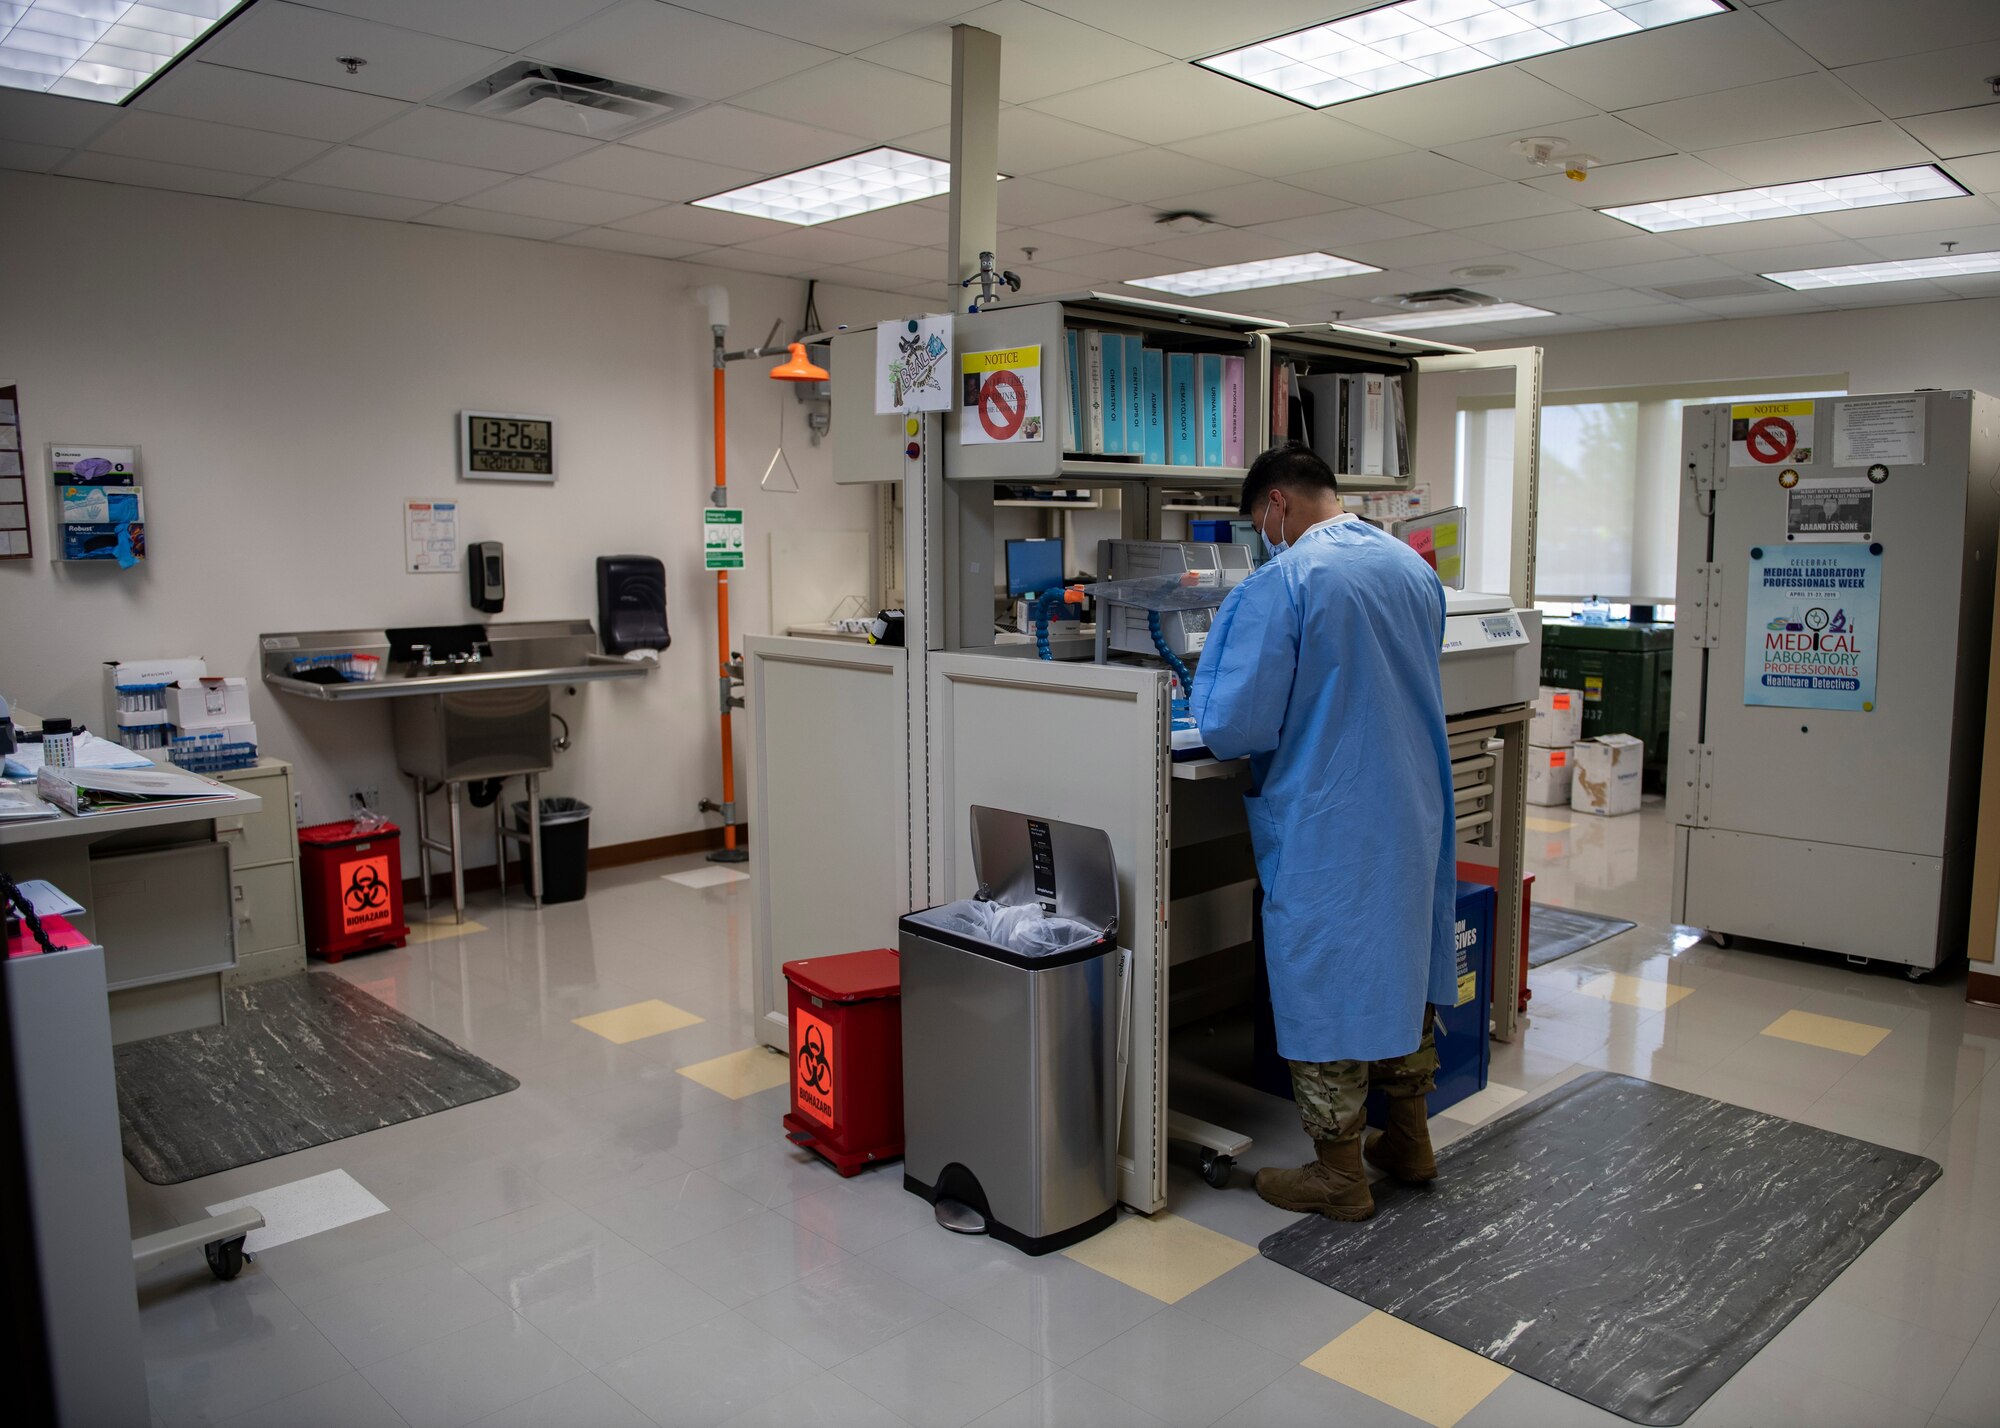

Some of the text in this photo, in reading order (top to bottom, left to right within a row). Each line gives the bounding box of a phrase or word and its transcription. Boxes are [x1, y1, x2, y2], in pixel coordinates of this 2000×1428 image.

[985, 352, 1018, 365] NOTICE
[1754, 405, 1789, 414] NOTICE
[483, 422, 532, 449] 13:26
[1828, 523, 1839, 531] ITS
[1840, 522, 1858, 530] GONE
[1763, 568, 1865, 577] MEDICAL LABORATORY
[1763, 578, 1865, 588] PROFESSIONALS WEEK
[1766, 633, 1861, 653] MEDICAL
[1765, 651, 1859, 665] LABORATORY
[1764, 663, 1858, 677] PROFESSIONALS
[1766, 674, 1855, 690] Healthcare Detectives
[347, 910, 389, 926] BIOHAZARD
[1118, 954, 1126, 977] cobas
[800, 1087, 832, 1117] BIOHAZARD
